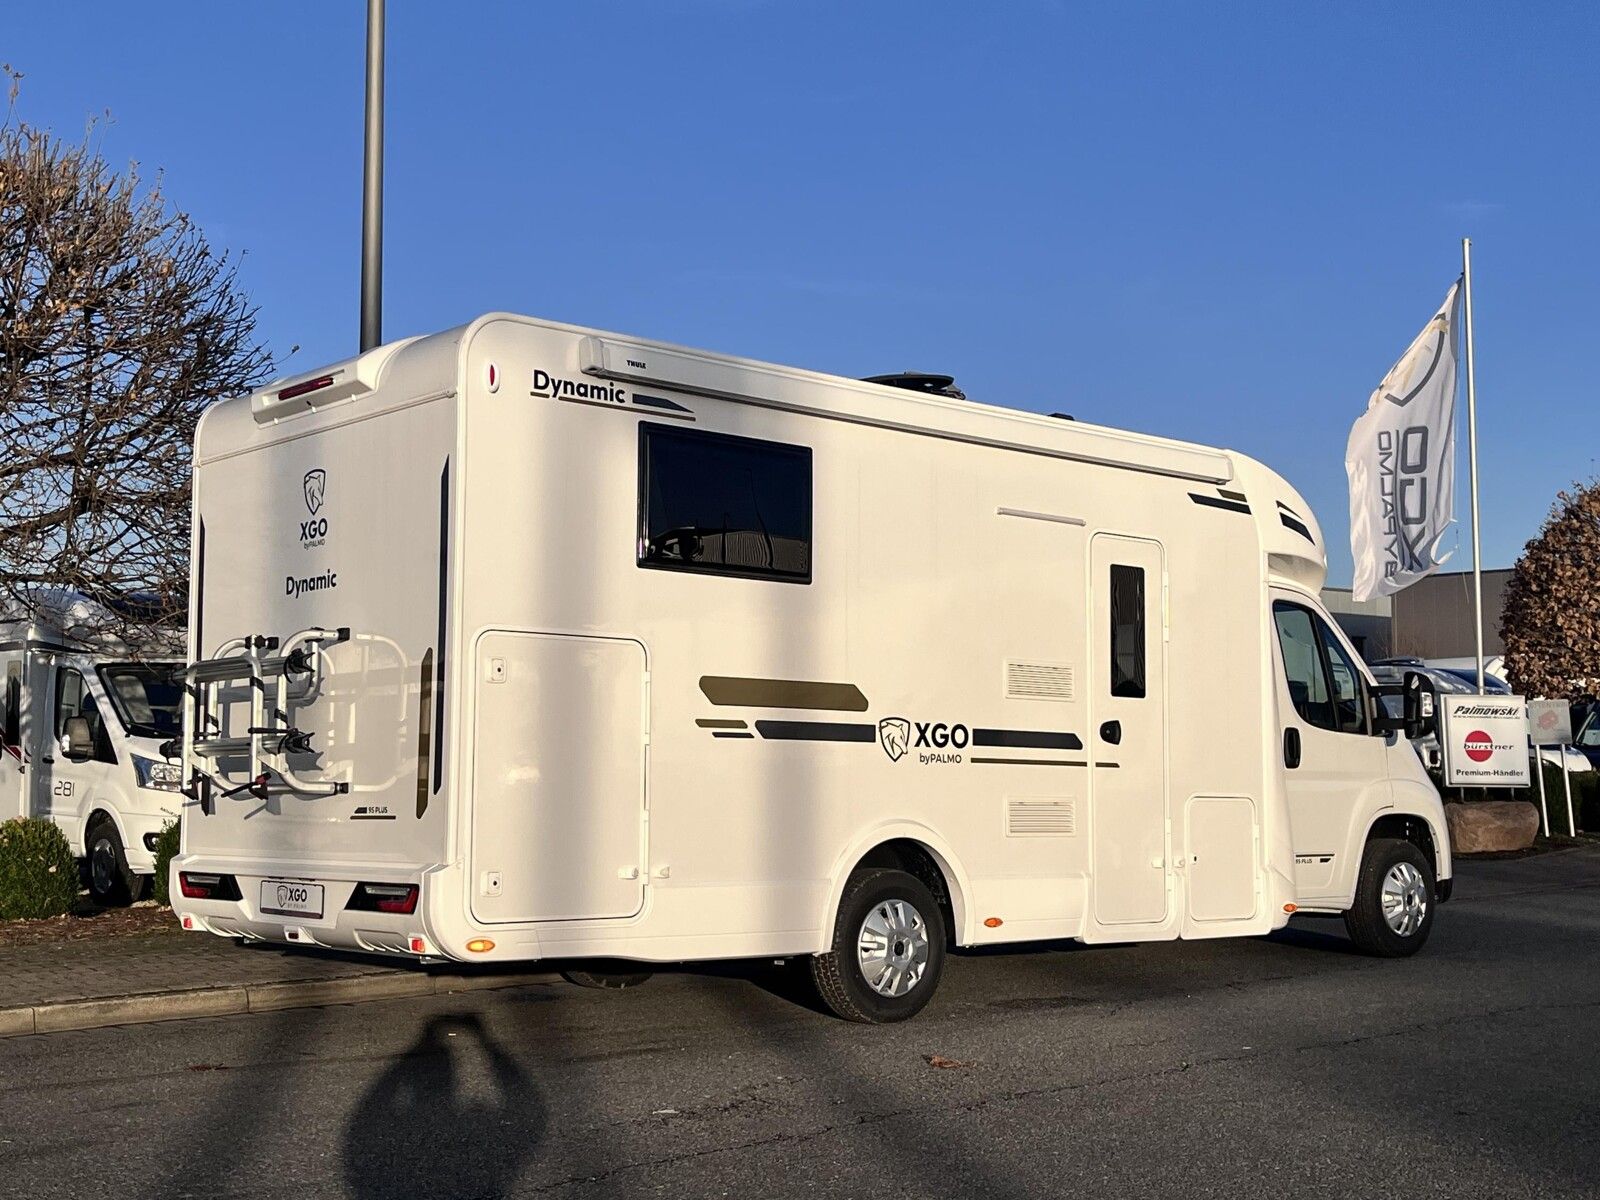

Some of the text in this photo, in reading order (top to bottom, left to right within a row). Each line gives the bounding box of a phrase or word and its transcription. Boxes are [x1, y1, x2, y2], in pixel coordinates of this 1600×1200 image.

[626, 360, 647, 369] THULE
[533, 369, 626, 404] Dynamic
[300, 518, 328, 541] XGO
[304, 538, 326, 550] byPALMO
[286, 568, 337, 599] Dynamic
[1453, 705, 1520, 716] Palmowski
[914, 722, 969, 749] XGO
[1463, 743, 1514, 751] bürstner
[919, 753, 962, 765] byPALMO
[1456, 769, 1524, 777] Premium-Händler
[54, 780, 75, 797] 281
[368, 806, 388, 814] 95 PLUS
[288, 888, 307, 902] XGO
